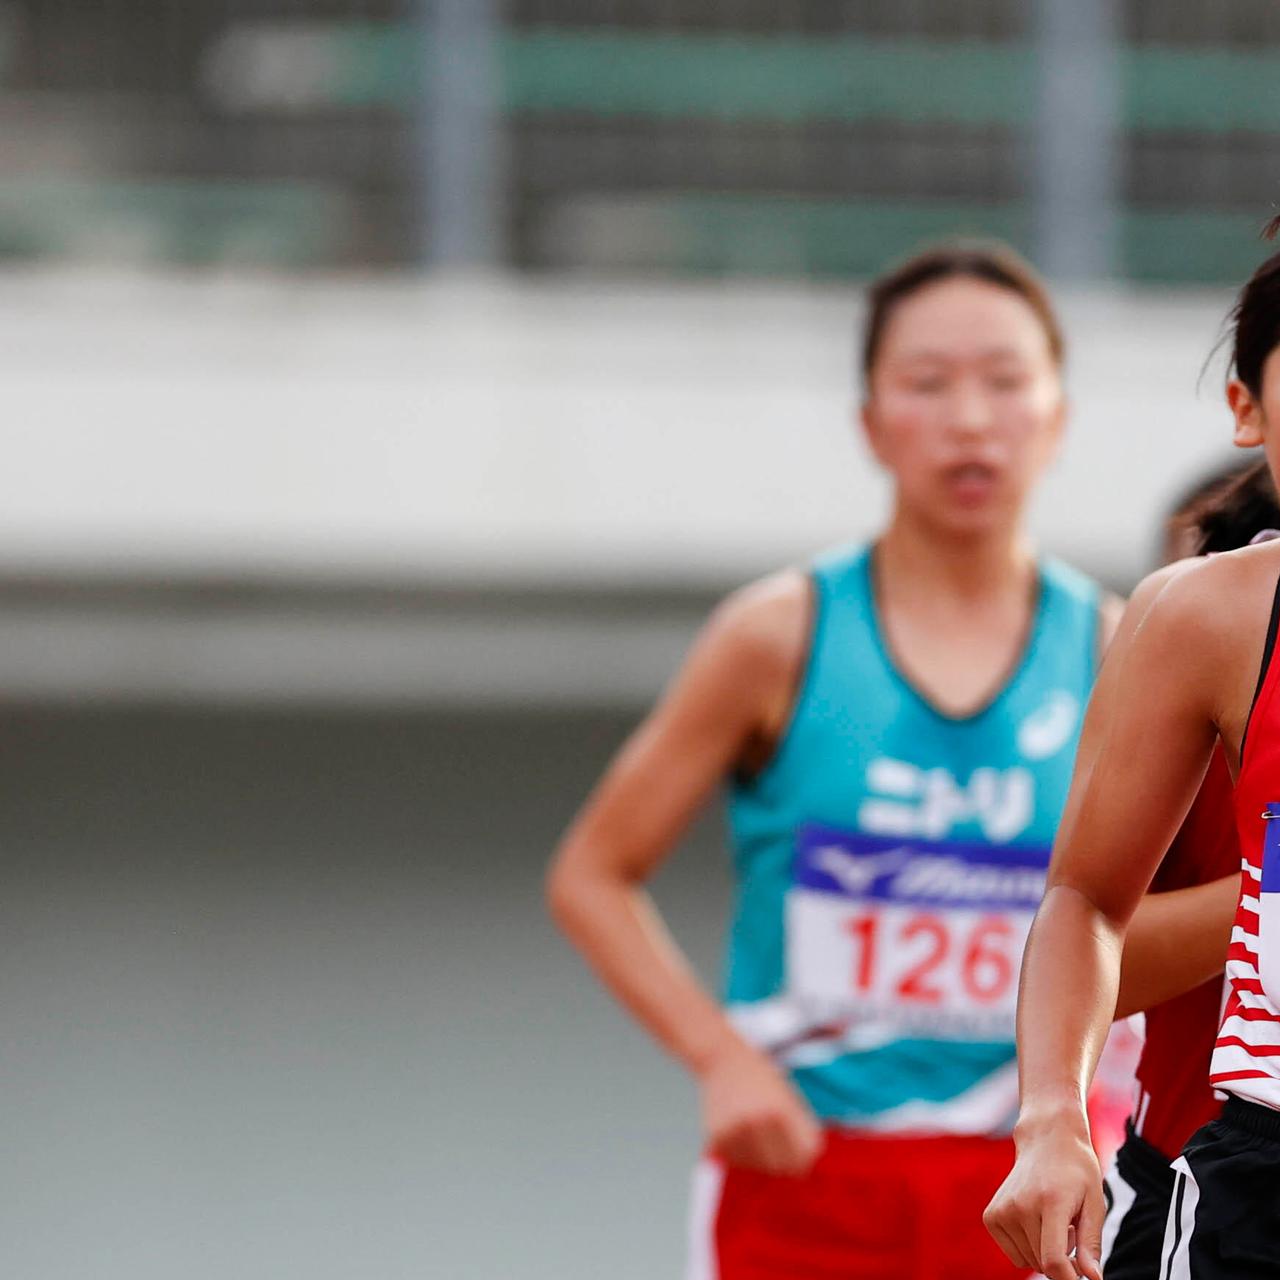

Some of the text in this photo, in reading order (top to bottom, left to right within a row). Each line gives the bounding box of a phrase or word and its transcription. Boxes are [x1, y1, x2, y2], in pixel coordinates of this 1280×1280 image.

[858, 758, 1035, 843] ニトリ
[845, 908, 1013, 1006] 126
